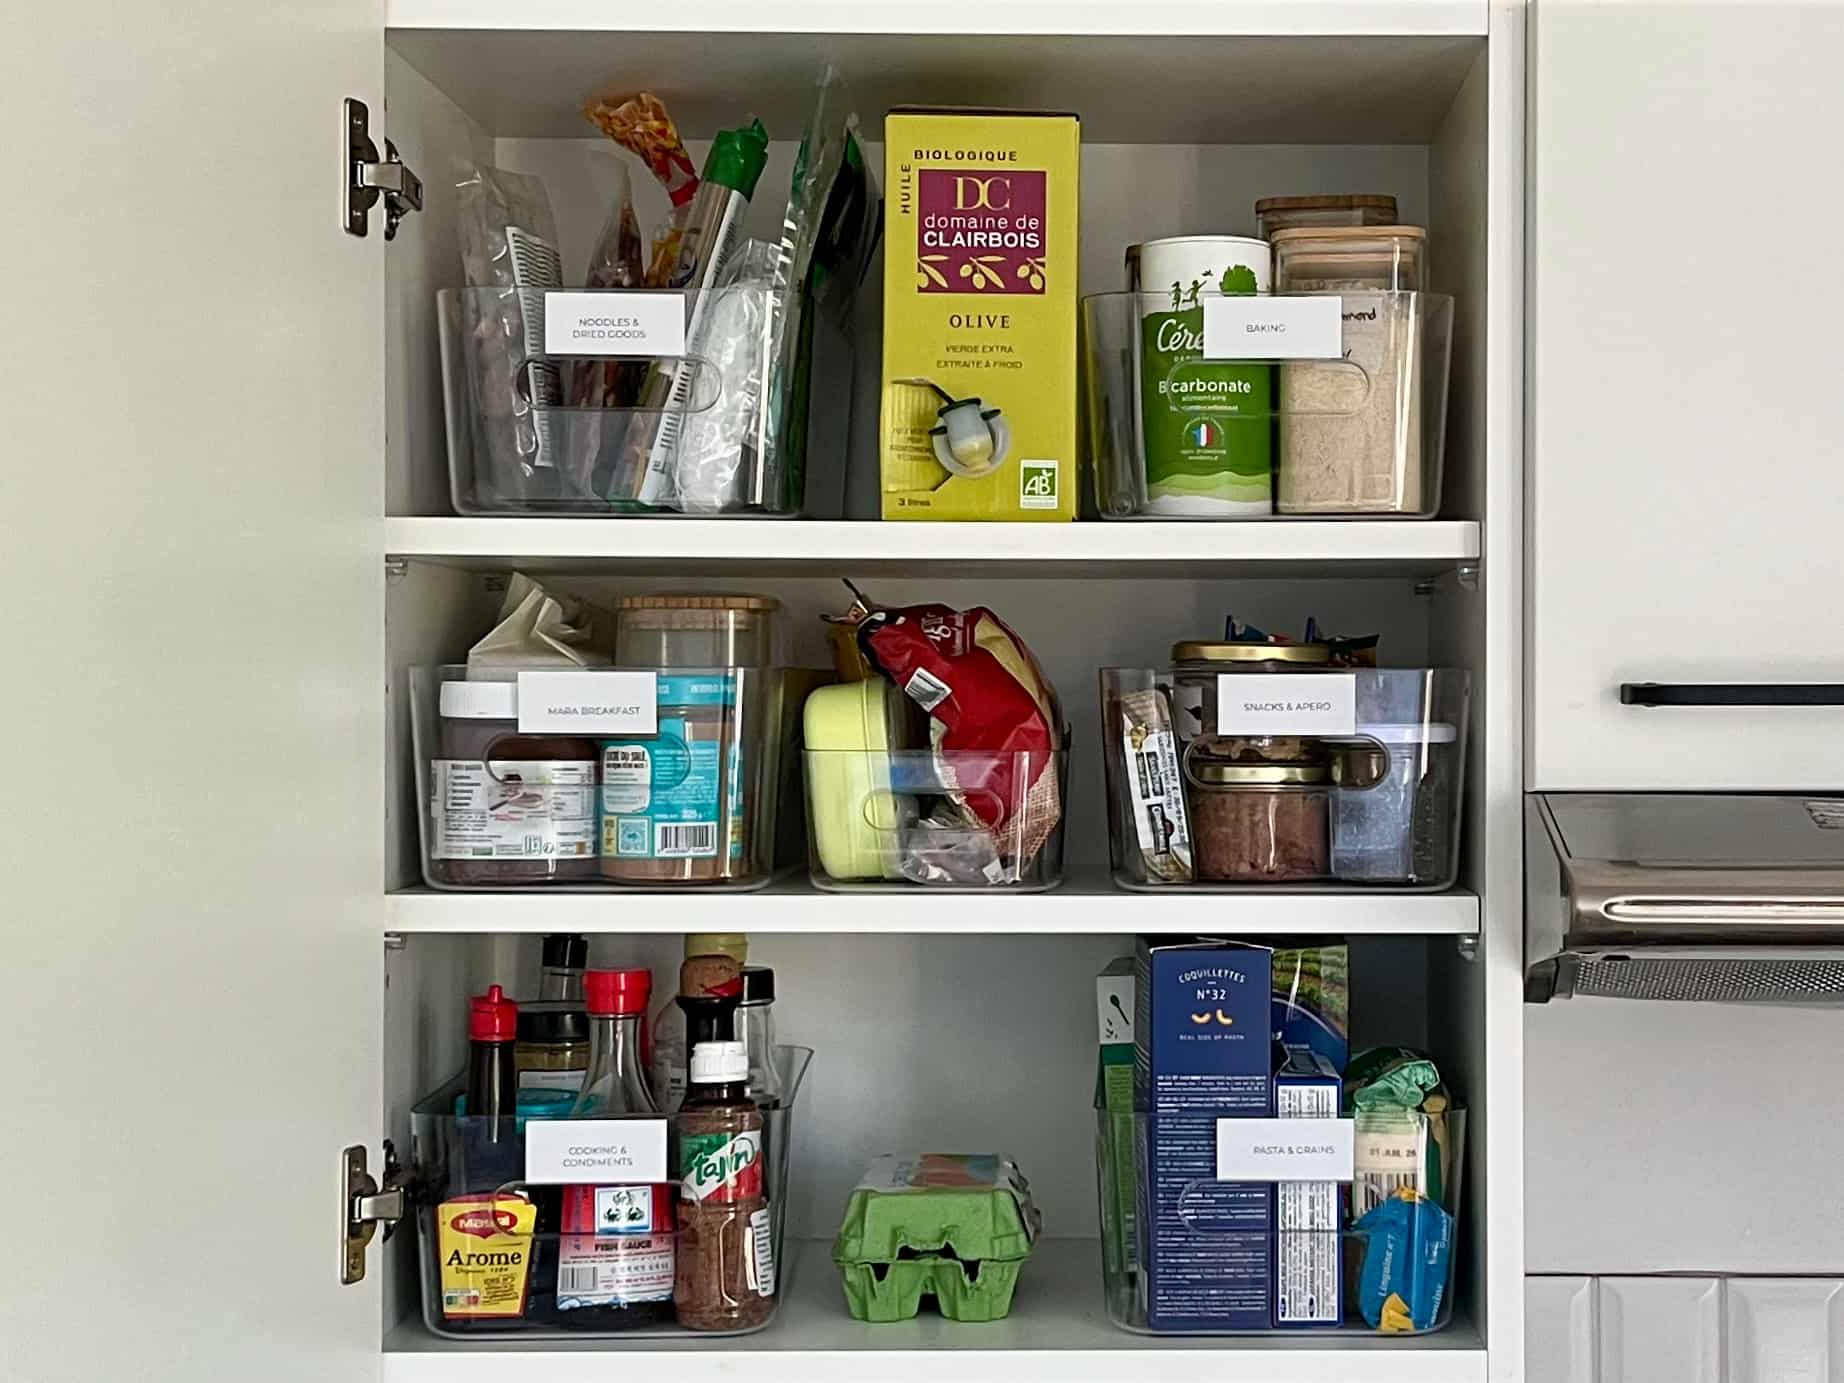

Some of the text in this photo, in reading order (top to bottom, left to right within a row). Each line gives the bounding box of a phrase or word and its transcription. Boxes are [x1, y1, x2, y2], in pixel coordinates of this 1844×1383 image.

[914, 150, 1018, 162] BIOLOGIQUE
[901, 164, 911, 214] HUILE
[952, 177, 1011, 211] DC
[924, 213, 1040, 230] domaine de
[923, 231, 1042, 248] CLAIRBOIS
[579, 318, 640, 327] NOODLES &
[949, 314, 1010, 329] OLIVE
[1246, 323, 1287, 333] BAKING
[573, 330, 647, 339] DRIED GOODS
[982, 345, 1014, 353] EXTRA
[936, 360, 983, 369] EXTRAITE
[1158, 378, 1251, 394] Bcarbonate
[1024, 474, 1051, 495] AB
[581, 706, 640, 716] BREAKFAST
[1243, 703, 1284, 711] SNACKS
[1286, 703, 1294, 711] &
[1178, 969, 1246, 984] COQUILLETTES
[568, 1146, 618, 1156] COOKING
[1253, 1146, 1336, 1155] PASTA & GRAINS
[563, 1158, 633, 1168] CONDIMENTS
[446, 1248, 522, 1266] Arome
